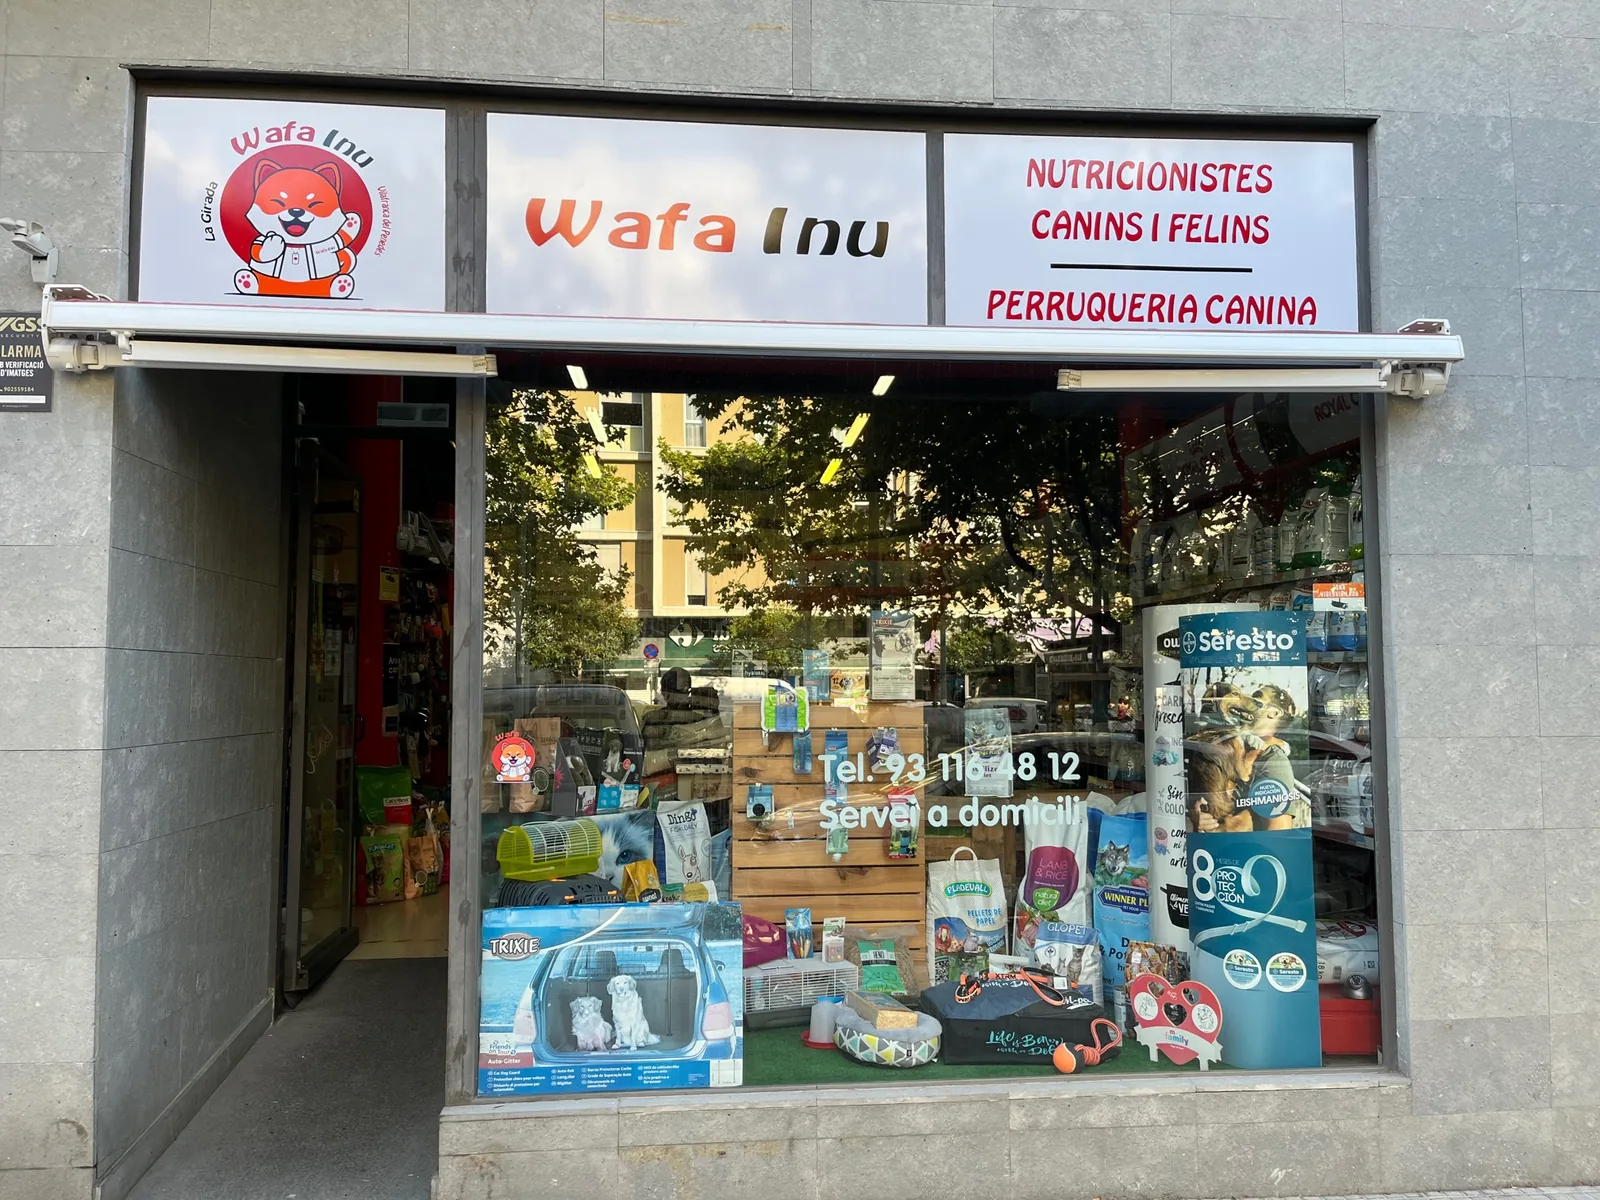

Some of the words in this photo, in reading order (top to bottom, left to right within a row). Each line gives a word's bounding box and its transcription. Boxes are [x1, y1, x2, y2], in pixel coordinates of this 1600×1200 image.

[230, 120, 316, 156] Wafa
[322, 129, 374, 169] Inu
[1026, 157, 1273, 195] NUTRICIONISTES
[200, 181, 218, 224] Girada
[205, 227, 216, 242] La
[525, 197, 736, 254] Wafa
[762, 206, 889, 258] Inu
[1031, 208, 1143, 243] CANINS
[1151, 212, 1160, 243] I
[1168, 212, 1270, 246] FELINS
[986, 289, 1199, 325] PERRUQUERIA
[1205, 293, 1318, 327] CANINA
[5, 360, 44, 369] VERIFICACIÓ
[0, 369, 34, 377] D'IMATGES
[1315, 394, 1351, 422] ROYAL
[1199, 630, 1294, 652] Seresto
[818, 752, 873, 783] Tel.
[885, 753, 926, 782] 93
[938, 752, 983, 782] 116
[999, 752, 1037, 781] 48
[1047, 752, 1080, 781] 12
[1167, 784, 1185, 800] Sin
[1236, 792, 1301, 808] LEISHMANIOSIS
[667, 809, 697, 825] Dingo
[819, 799, 918, 829] Servei
[928, 804, 948, 828] a
[959, 795, 1080, 828] domicili
[1040, 857, 1068, 869] LAMB
[1035, 868, 1043, 878] &
[1045, 870, 1068, 880] RICE
[1193, 849, 1214, 901] 8
[1216, 870, 1237, 881] PRO
[946, 883, 988, 894] PLADEVALL
[1216, 881, 1236, 892] TEC
[1037, 899, 1051, 907] diet
[1104, 891, 1137, 906] WINNER
[1217, 891, 1245, 904] CIÓN
[967, 909, 992, 917] PELLETS
[1047, 922, 1086, 935] GLOPET
[489, 937, 539, 955] TRIXIE
[1234, 965, 1254, 973] Seresto
[985, 1030, 1015, 1047] Life
